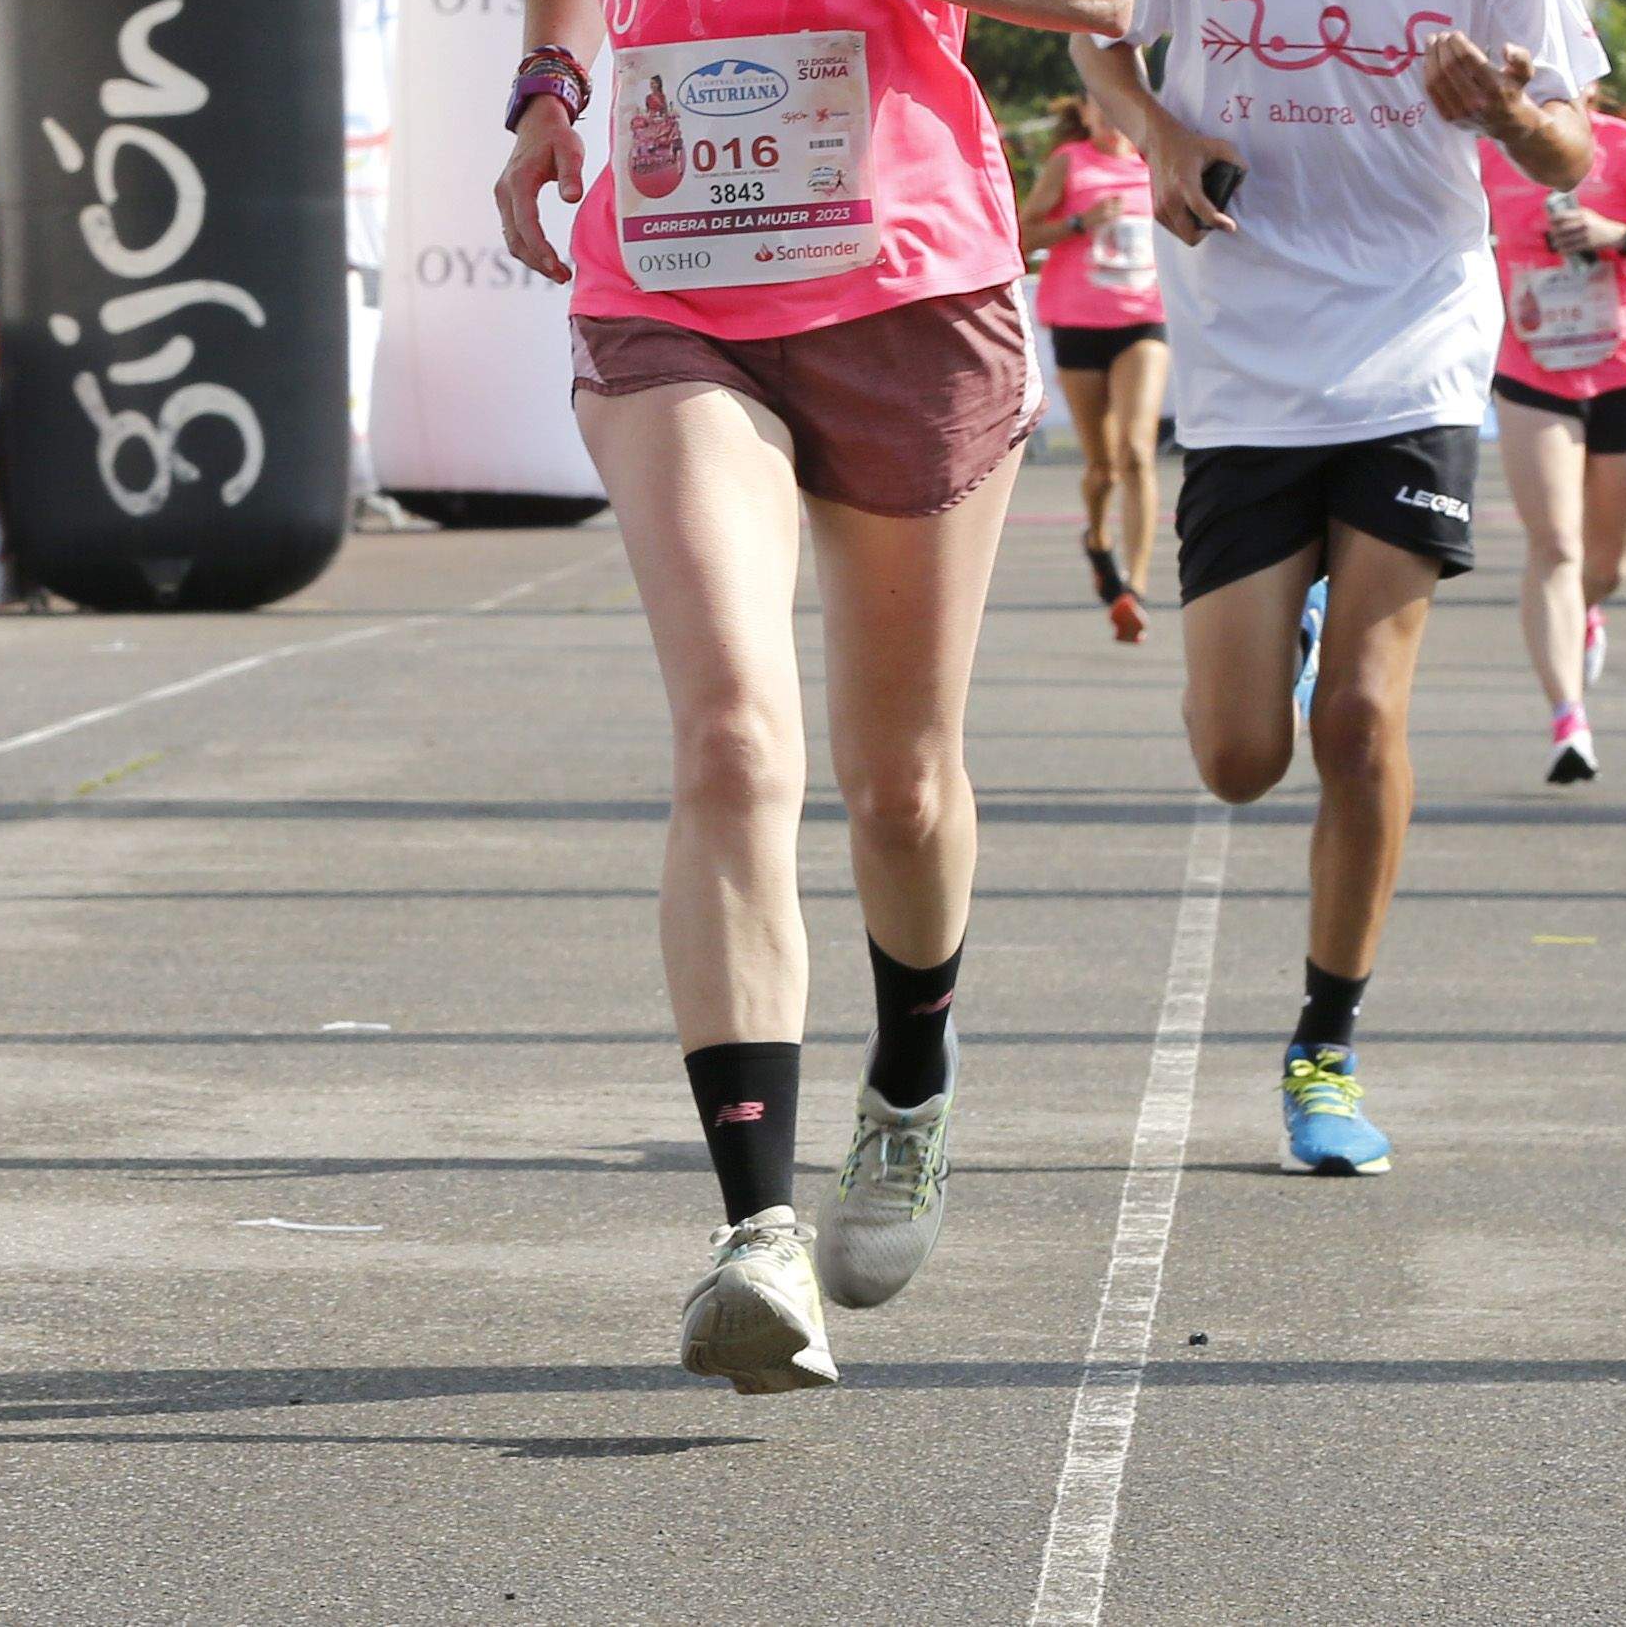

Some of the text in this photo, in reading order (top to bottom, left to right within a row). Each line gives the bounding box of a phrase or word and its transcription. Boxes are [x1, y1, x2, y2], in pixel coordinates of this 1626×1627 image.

[797, 64, 850, 82] SUMA
[685, 83, 781, 105] ASTURIANA
[1219, 94, 1255, 125] ¿Y
[1268, 98, 1356, 126] ahora
[692, 135, 780, 173] 016
[709, 181, 766, 205] 3843
[643, 209, 851, 235] CARRERA DE LA MUJER 2023
[638, 240, 861, 273] OYSHO Santander
[1394, 485, 1471, 523] LEGEA
